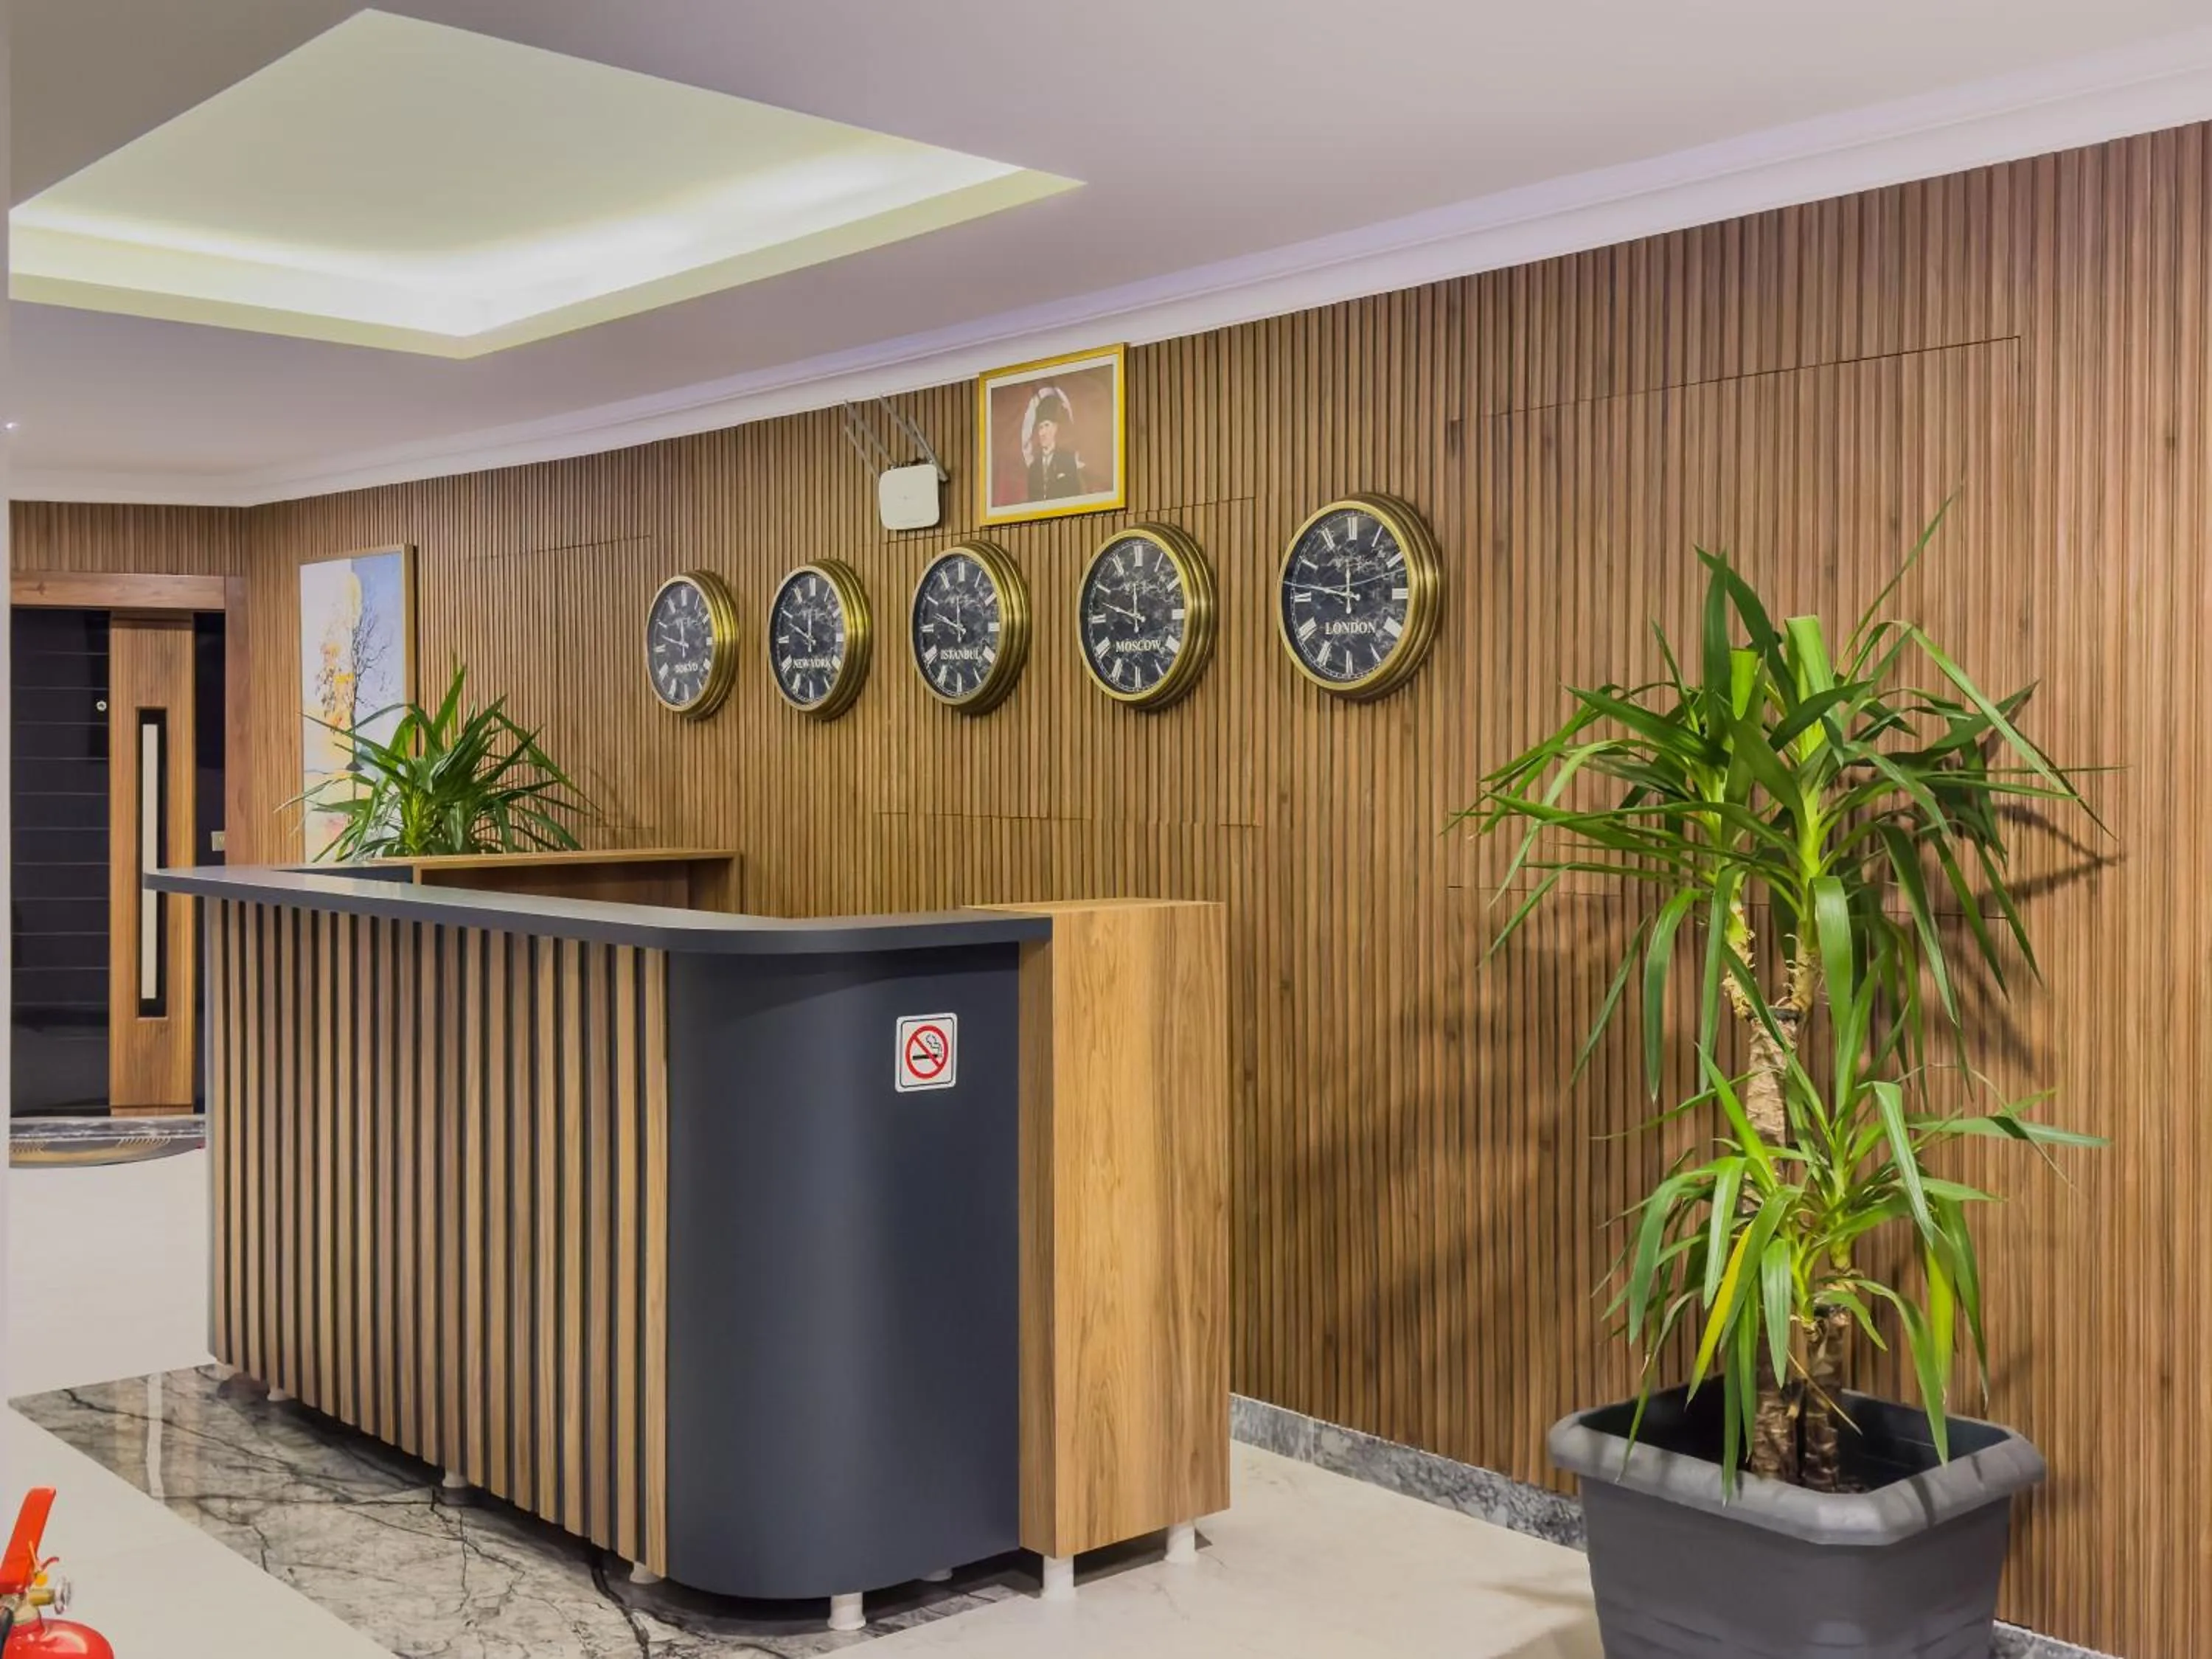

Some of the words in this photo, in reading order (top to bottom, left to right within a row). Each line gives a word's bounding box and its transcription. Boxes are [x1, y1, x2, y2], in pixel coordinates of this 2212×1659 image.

[1325, 621, 1376, 635] LONDON
[1116, 639, 1161, 653] MOSCOW
[940, 649, 980, 660] ISTANBUL
[810, 658, 831, 668] YORK
